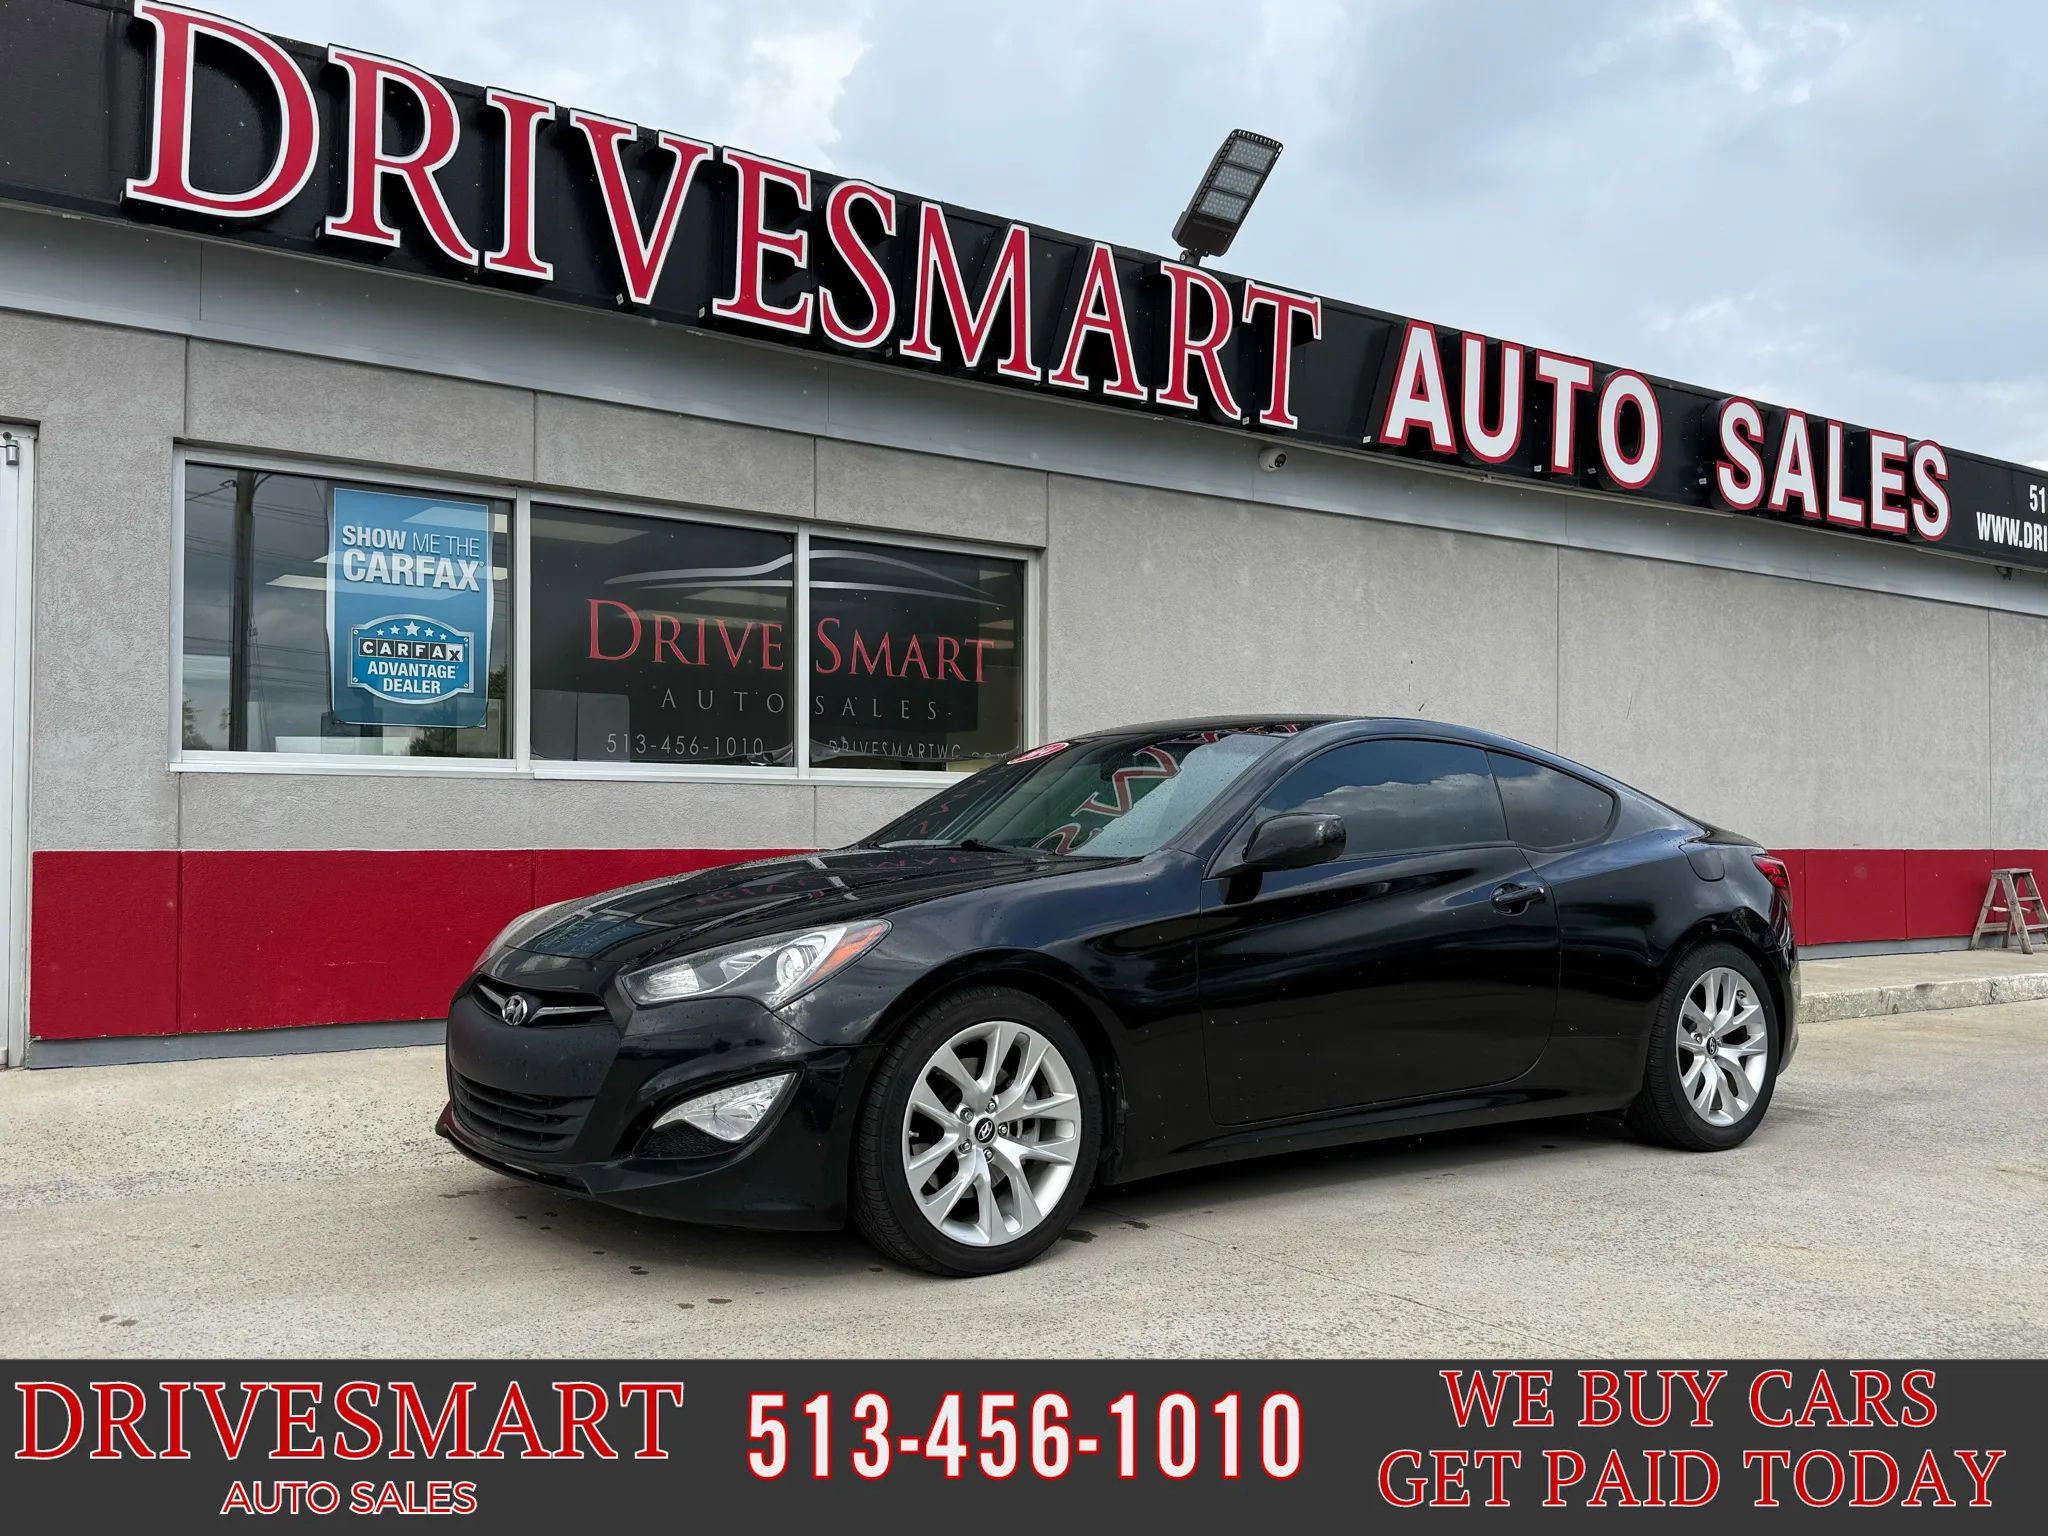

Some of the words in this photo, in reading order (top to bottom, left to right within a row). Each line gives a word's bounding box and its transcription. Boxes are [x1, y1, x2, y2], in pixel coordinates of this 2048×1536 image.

[125, 1, 1321, 430] DRIVESMART
[1381, 319, 1662, 490] AUTO
[1716, 396, 1951, 542] SALES
[342, 524, 406, 551] SHOW
[412, 531, 441, 554] ME
[445, 535, 480, 558] THE
[1976, 511, 2048, 552] WWW.DRI
[343, 548, 480, 592] CARFAX
[361, 640, 462, 662] CARFAX
[584, 598, 785, 671] DRIVE
[815, 617, 995, 683] SMART
[367, 660, 457, 680] ADVANTAGE
[383, 678, 441, 695] DEALER
[660, 687, 785, 713] AUTO
[814, 695, 937, 720] SALES
[606, 733, 764, 756] 513-456-1010
